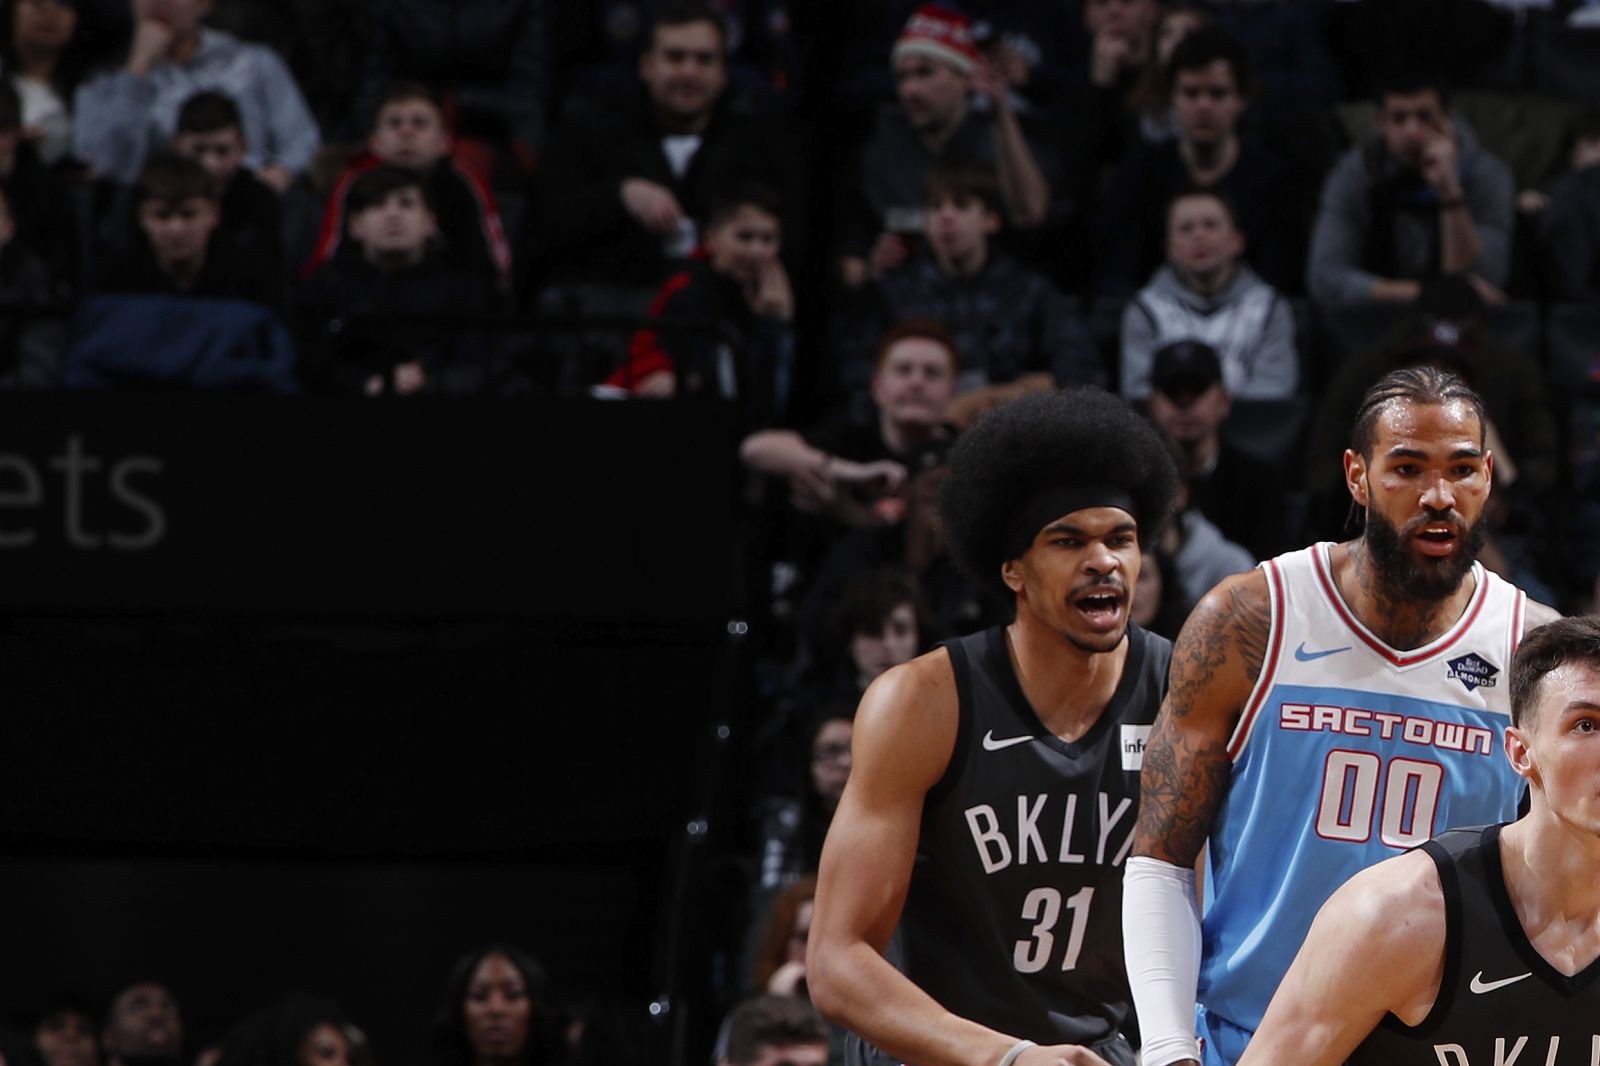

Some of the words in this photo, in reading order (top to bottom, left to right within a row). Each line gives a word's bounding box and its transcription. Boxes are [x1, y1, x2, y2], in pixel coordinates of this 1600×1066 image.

[1448, 670, 1494, 686] ALMONDS
[1280, 703, 1493, 755] SACTOWN
[1315, 749, 1444, 849] 00
[1013, 886, 1095, 974] 31
